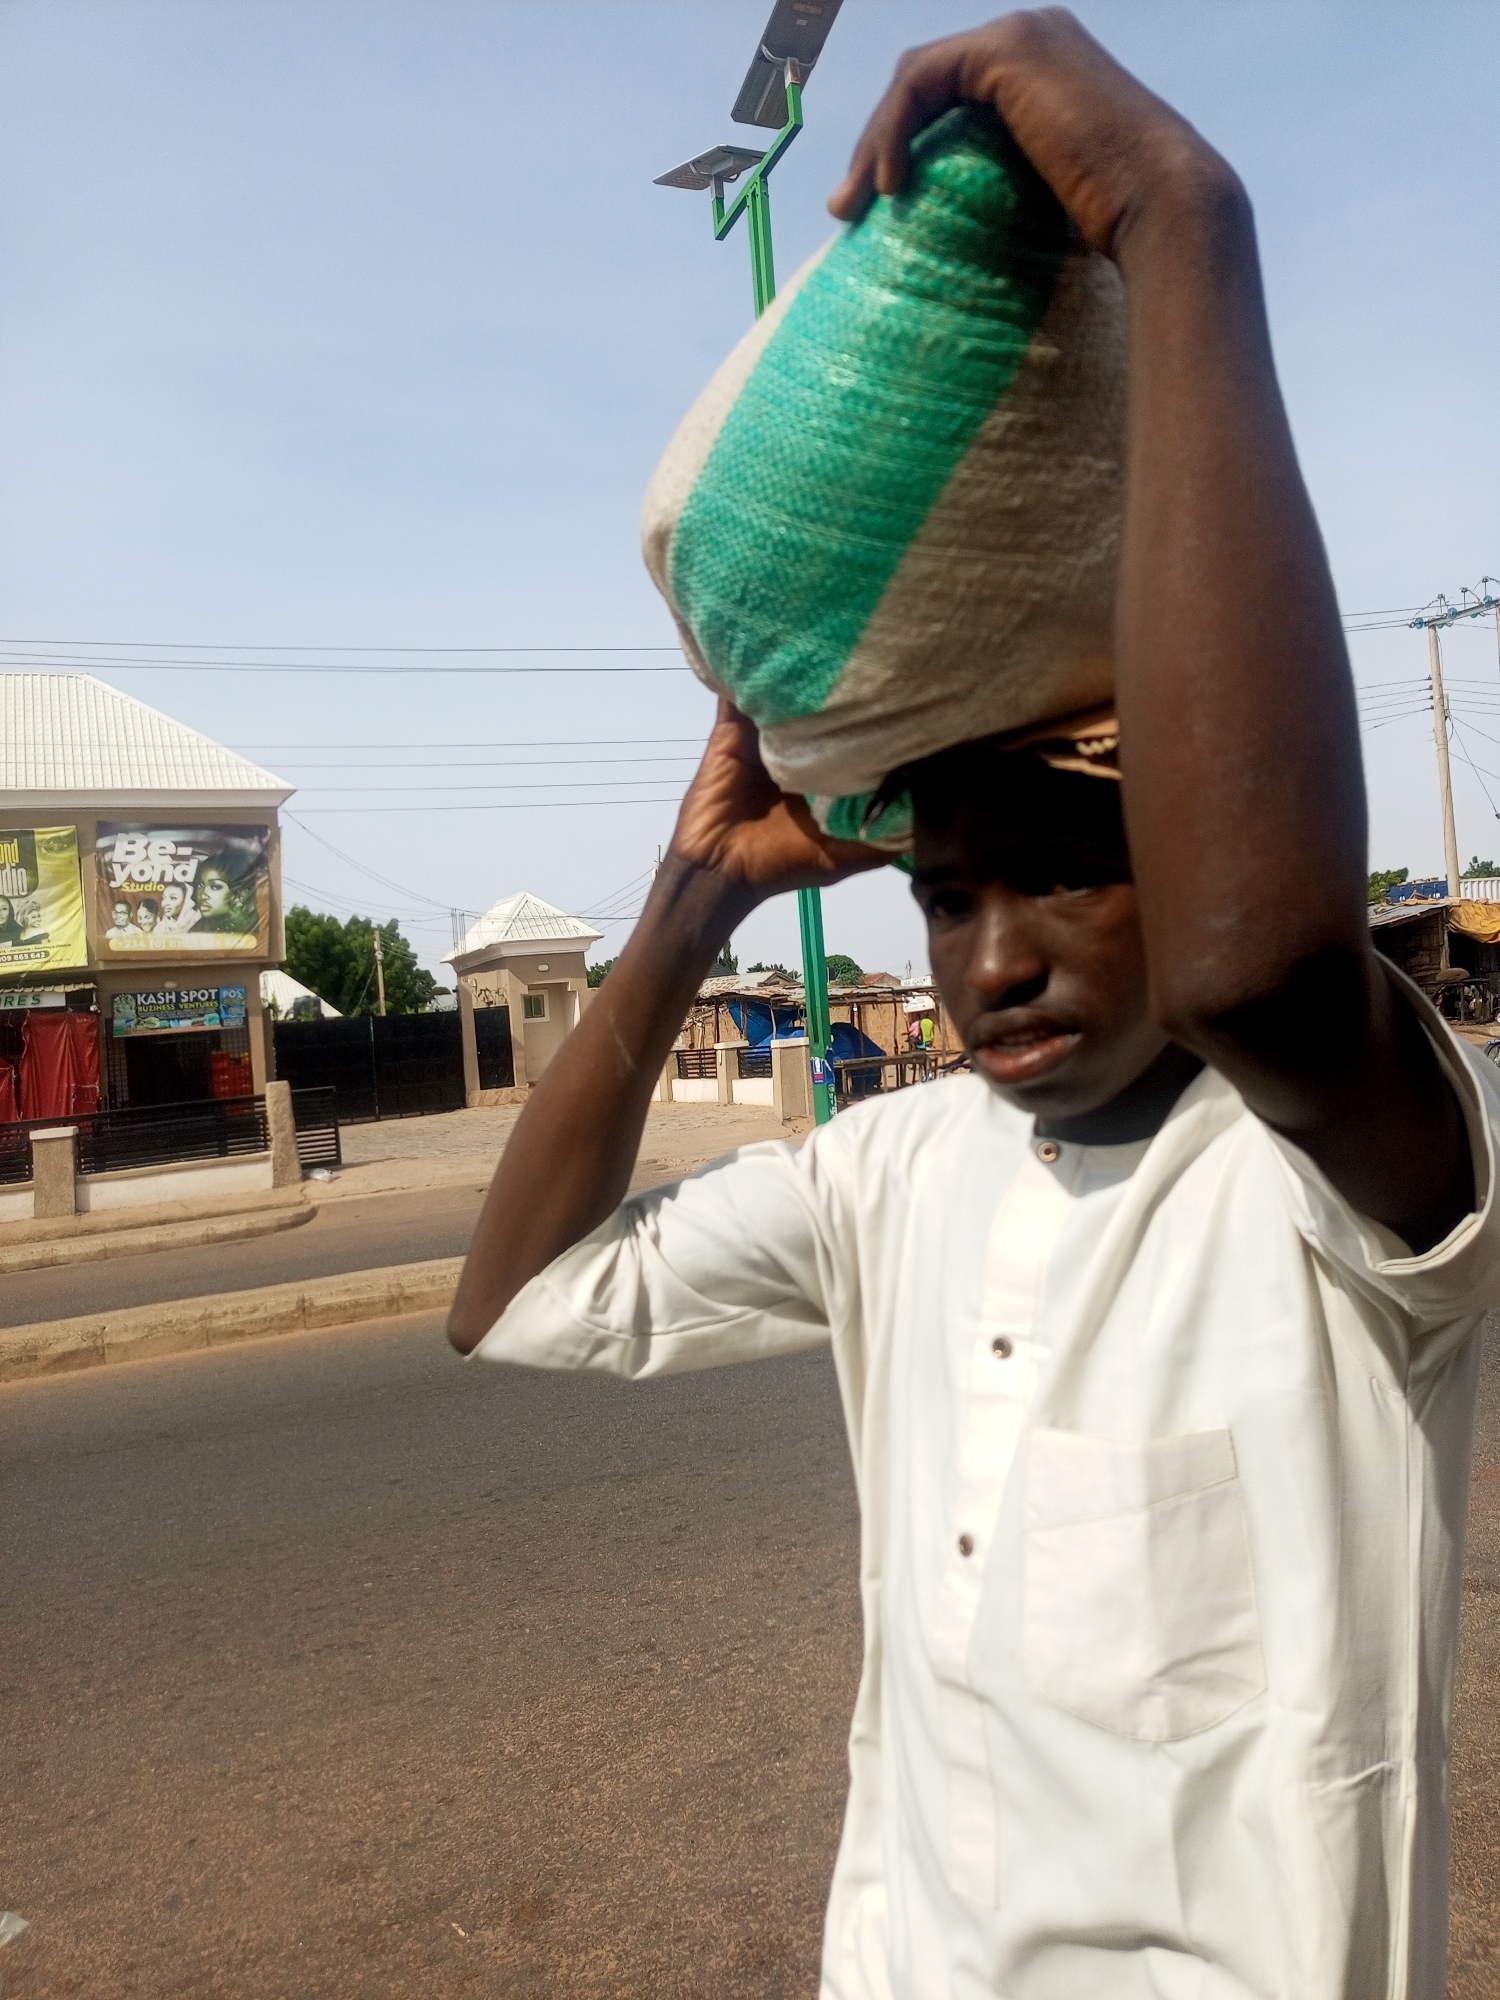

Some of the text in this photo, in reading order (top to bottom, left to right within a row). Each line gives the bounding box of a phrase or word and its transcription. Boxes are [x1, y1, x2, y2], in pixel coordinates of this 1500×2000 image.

[112, 833, 193, 863] Be-
[109, 858, 198, 888] yond
[121, 881, 165, 892] Studio
[0, 995, 41, 1007] RES
[136, 988, 218, 1005] KASH SPOT
[137, 1003, 176, 1012] BUZINESS
[178, 1001, 219, 1010] VENTURES
